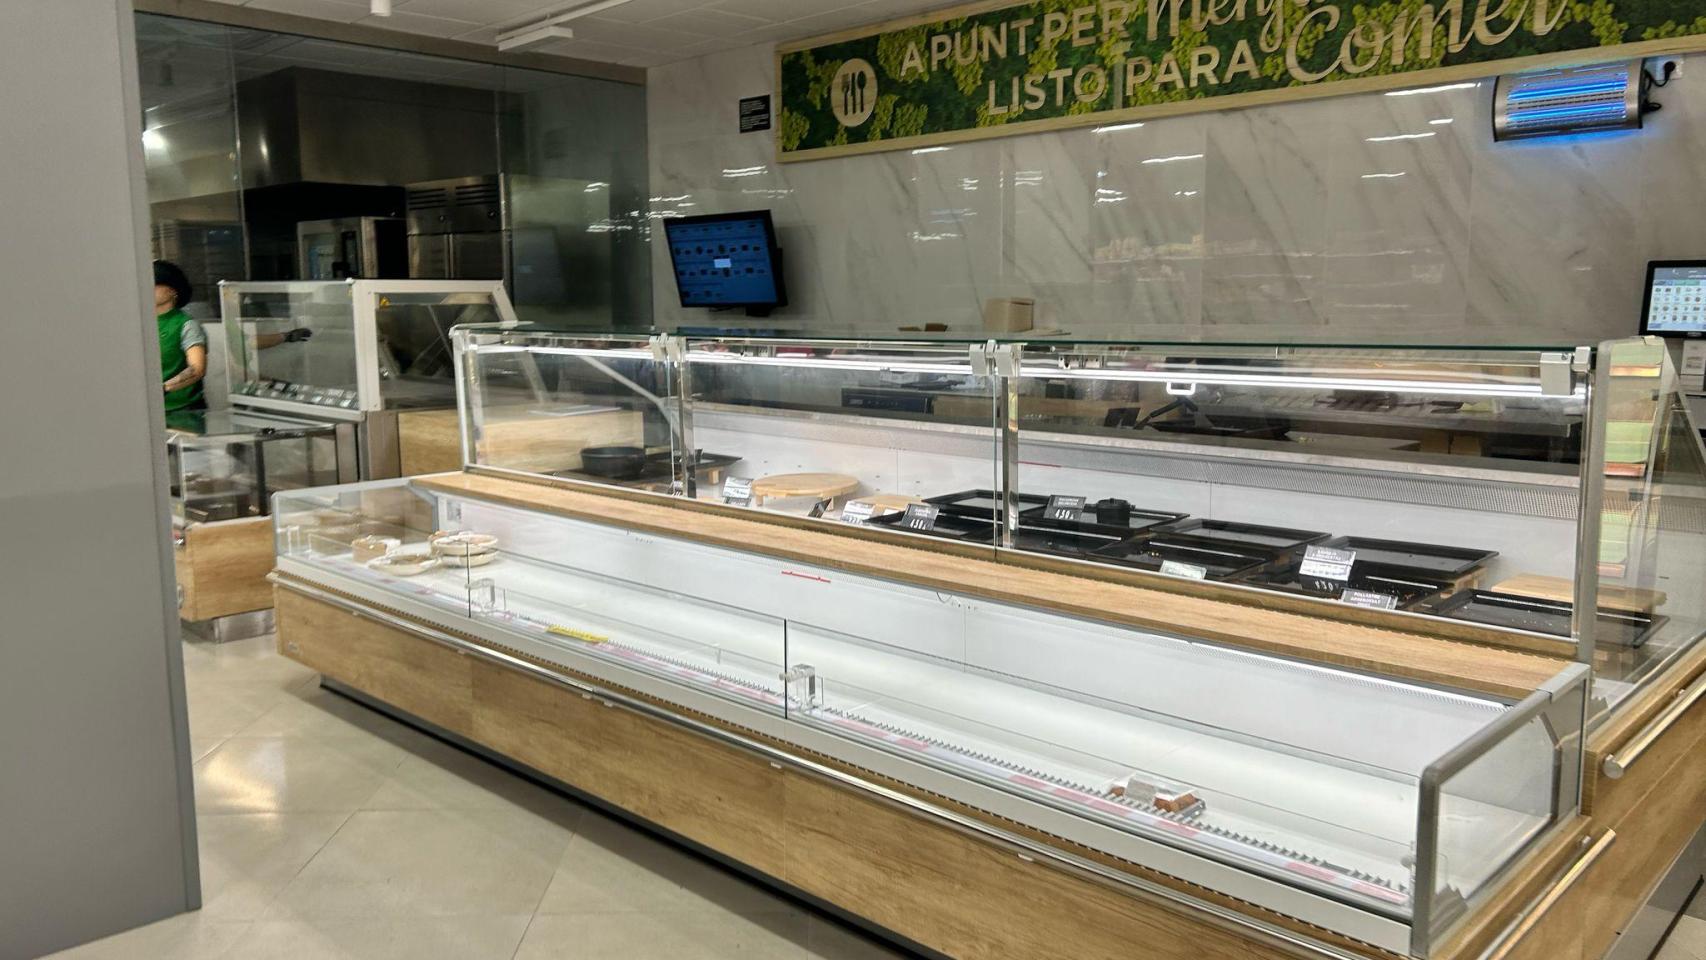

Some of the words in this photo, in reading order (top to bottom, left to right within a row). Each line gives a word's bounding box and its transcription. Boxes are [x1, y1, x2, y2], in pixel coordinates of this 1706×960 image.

[987, 63, 1108, 116] LISTO
[1126, 39, 1262, 97] PARA
[1285, 0, 1568, 82] Comer
[1042, 2, 1131, 50] PER
